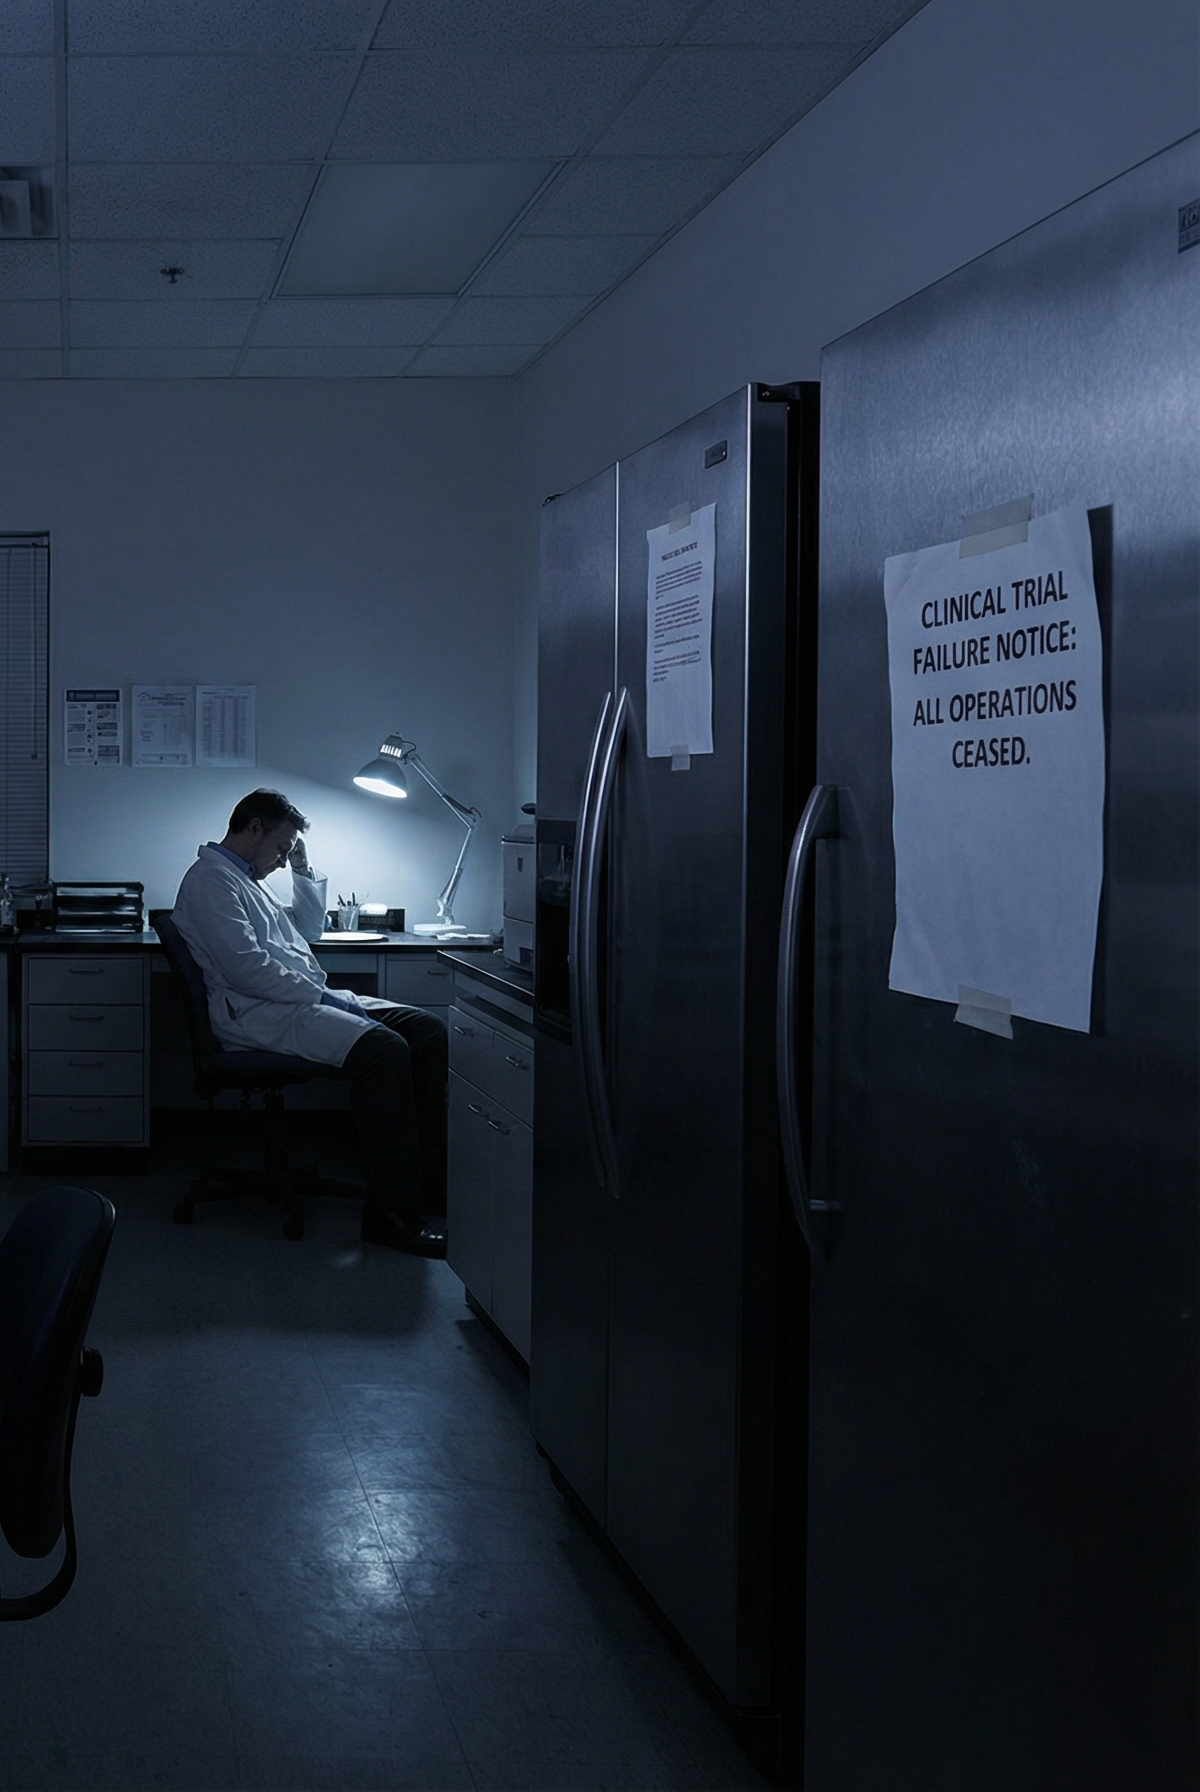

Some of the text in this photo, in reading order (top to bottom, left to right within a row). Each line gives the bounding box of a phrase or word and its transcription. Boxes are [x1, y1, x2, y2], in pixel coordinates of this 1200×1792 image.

[921, 570, 1068, 629] CLINICAL TRIAL
[913, 620, 1076, 675] FAILURE NOTICE:
[913, 679, 1077, 726] ALL OPERATIONS
[952, 736, 1030, 769] CEASED.
